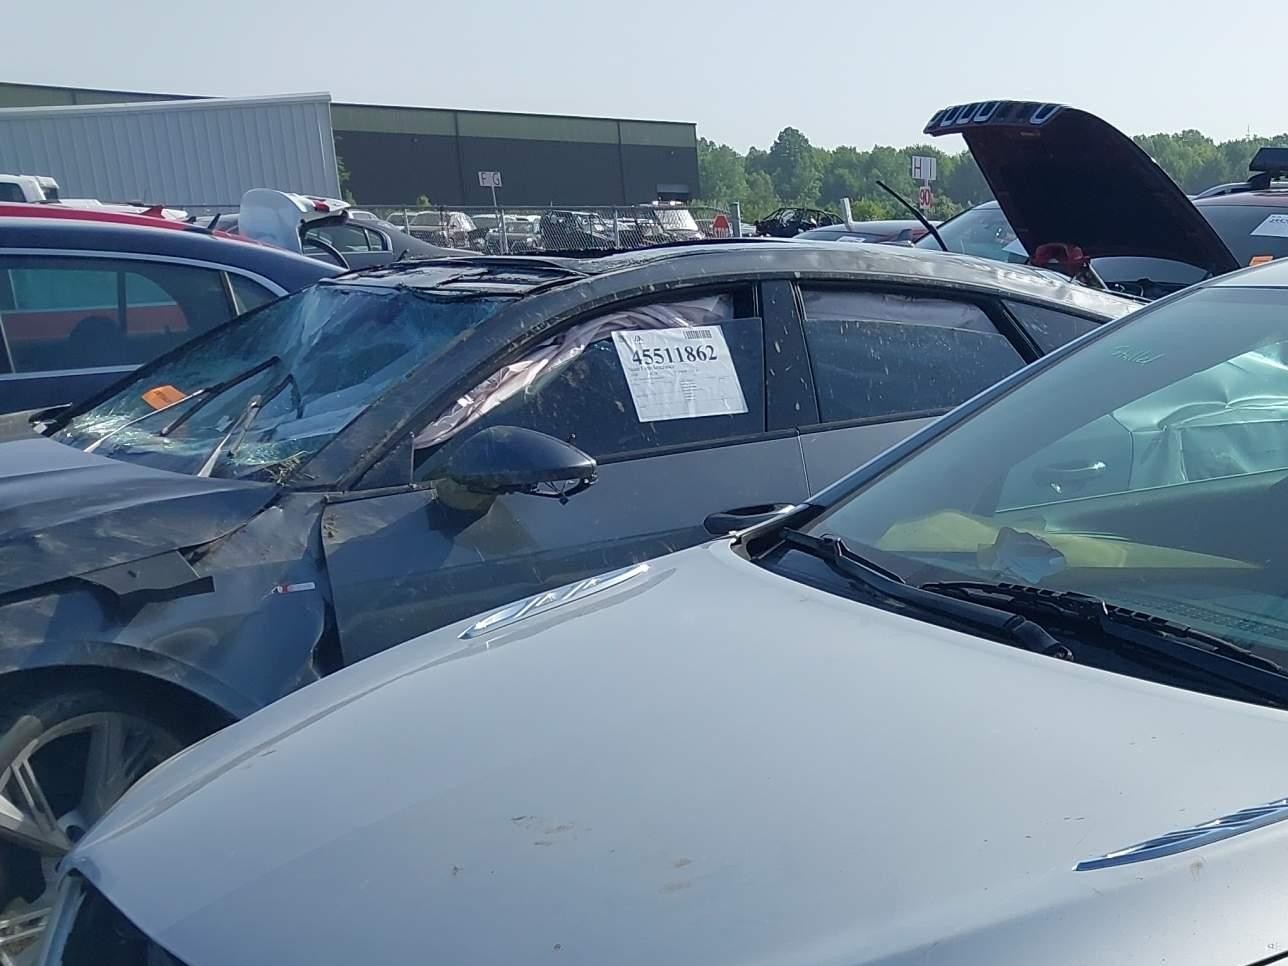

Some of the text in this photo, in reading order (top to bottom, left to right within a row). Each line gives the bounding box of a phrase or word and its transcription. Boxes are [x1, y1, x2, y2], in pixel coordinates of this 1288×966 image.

[914, 157, 922, 178] H
[920, 188, 931, 206] 90
[632, 345, 717, 365] 45511862
